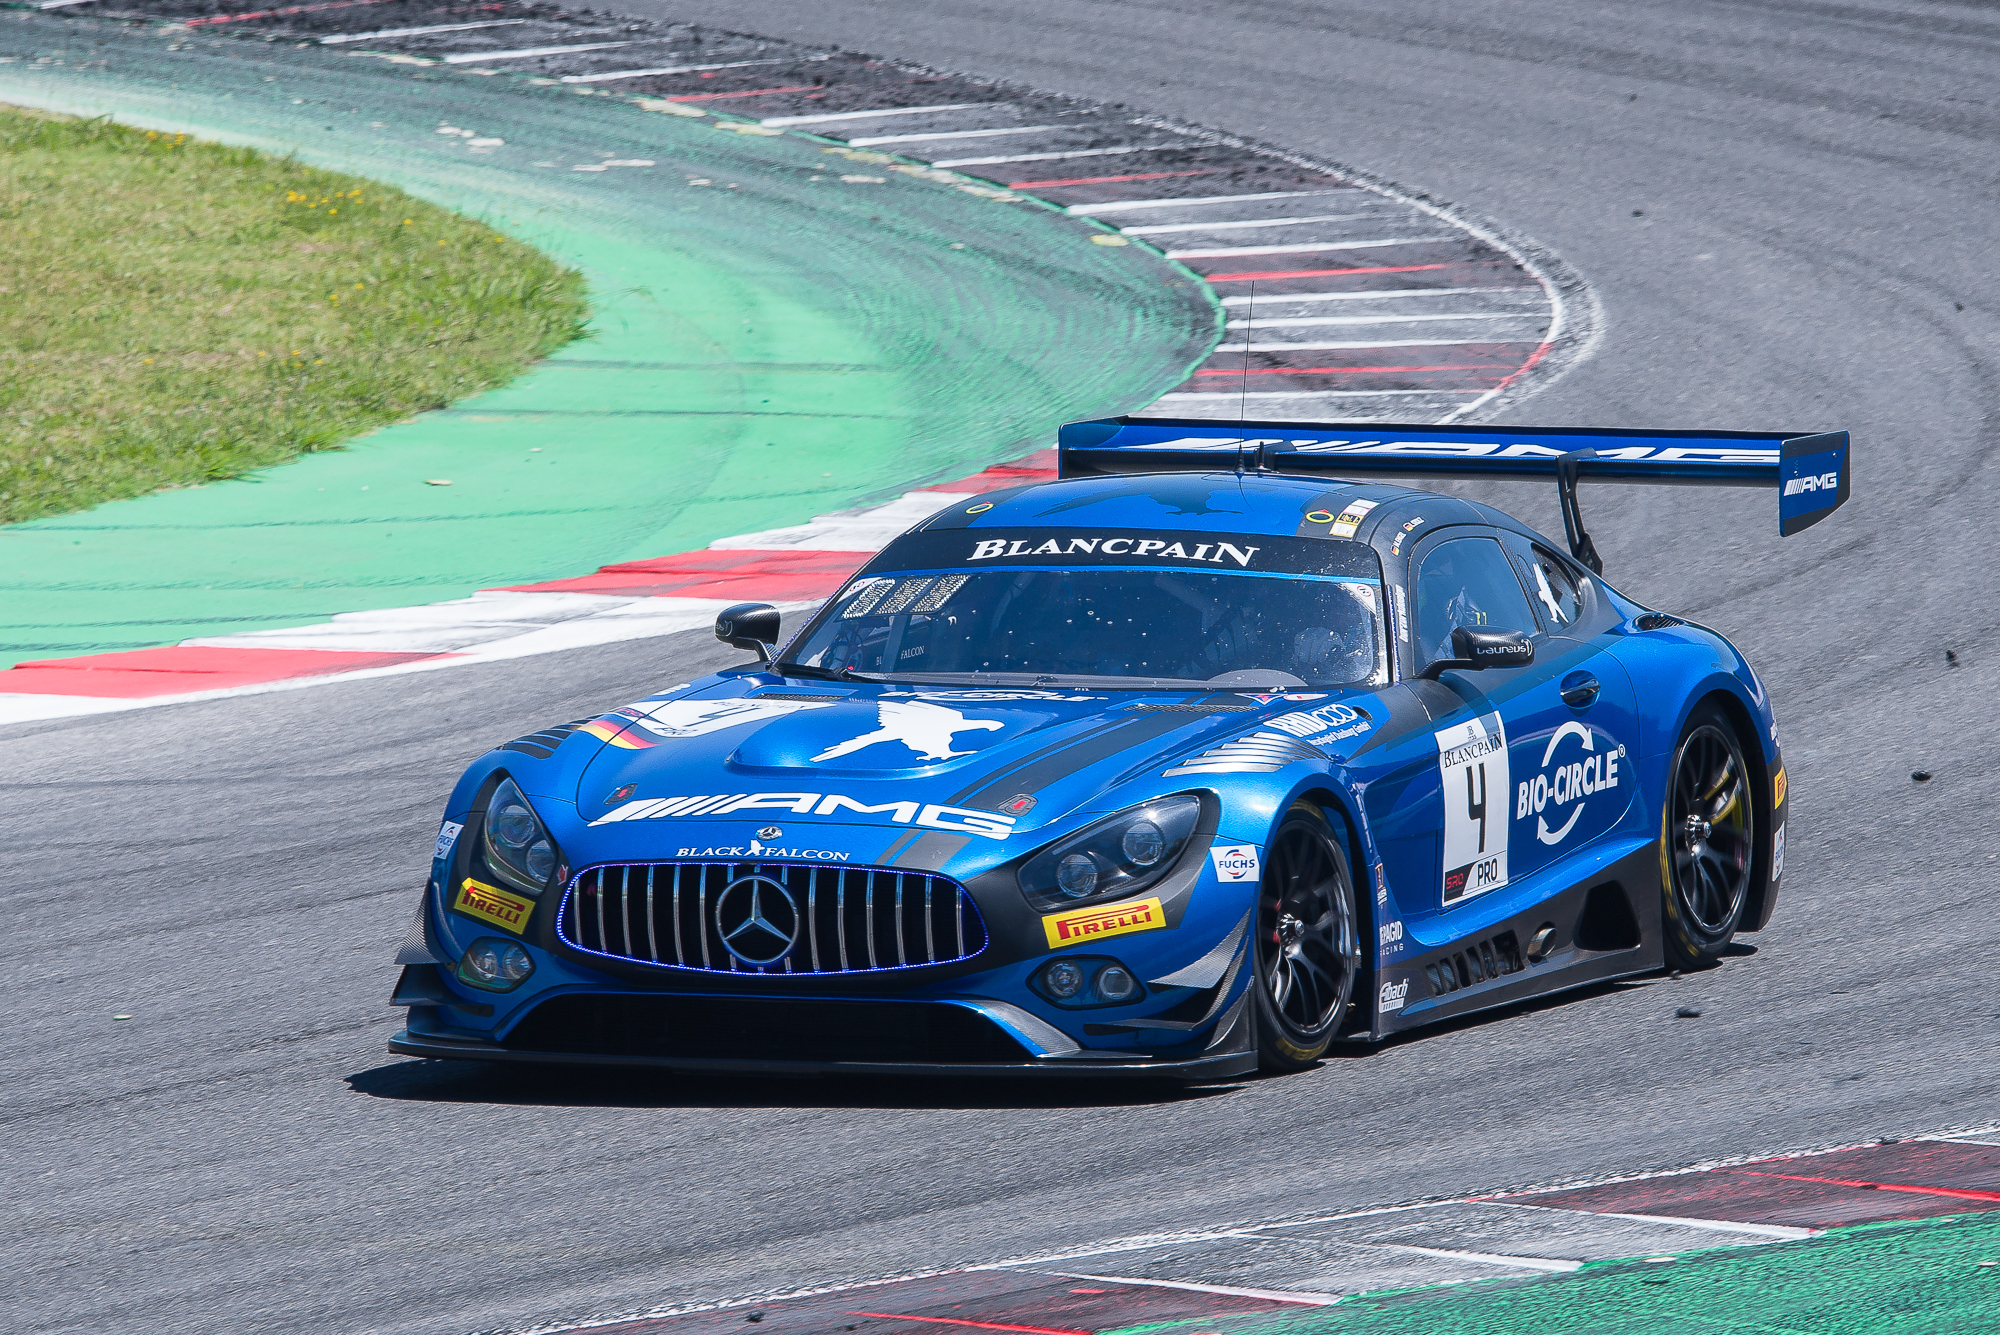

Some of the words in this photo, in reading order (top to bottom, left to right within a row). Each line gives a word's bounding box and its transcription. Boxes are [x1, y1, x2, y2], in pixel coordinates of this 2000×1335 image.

[966, 537, 1260, 567] BLANCPAIN
[1444, 732, 1503, 768] BLANCPAIN
[1465, 762, 1487, 855] 4
[675, 846, 745, 858] BLACK
[763, 847, 850, 861] FALCON
[1218, 859, 1256, 869] FUCHS
[1446, 872, 1465, 890] SRO
[1477, 858, 1499, 887] PRO
[461, 886, 526, 925] PIRELLI
[1056, 904, 1152, 941] PIRELLI
